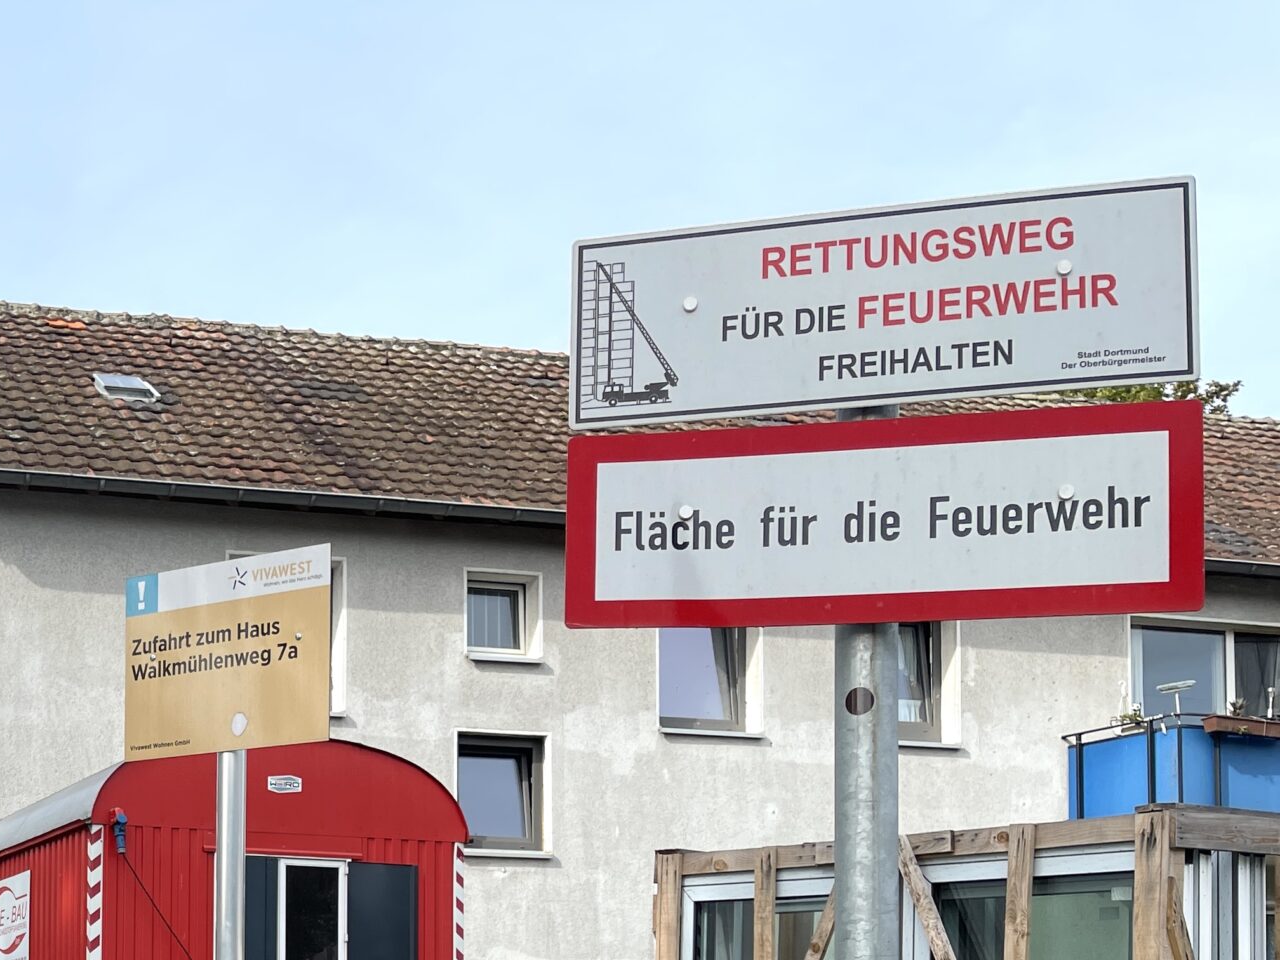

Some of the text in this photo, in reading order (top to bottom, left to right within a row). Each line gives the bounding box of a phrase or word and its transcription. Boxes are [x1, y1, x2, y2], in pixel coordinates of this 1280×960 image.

[761, 216, 1075, 280] RETTUNGSWEG
[722, 274, 1119, 342] FÜR DIE FEUERWEHR
[818, 339, 1014, 382] FREIHALTEN
[1077, 347, 1149, 359] Stadt Dortmund
[1080, 355, 1166, 367] Oberbürgermeister
[614, 485, 1151, 552] Fläche für die Feuerwehr
[252, 560, 312, 582] VIVAWEST
[132, 620, 280, 656] Zufahrt zum Haus
[131, 643, 299, 681] Walkmühlenweg 7a
[11, 901, 28, 923] BAU
